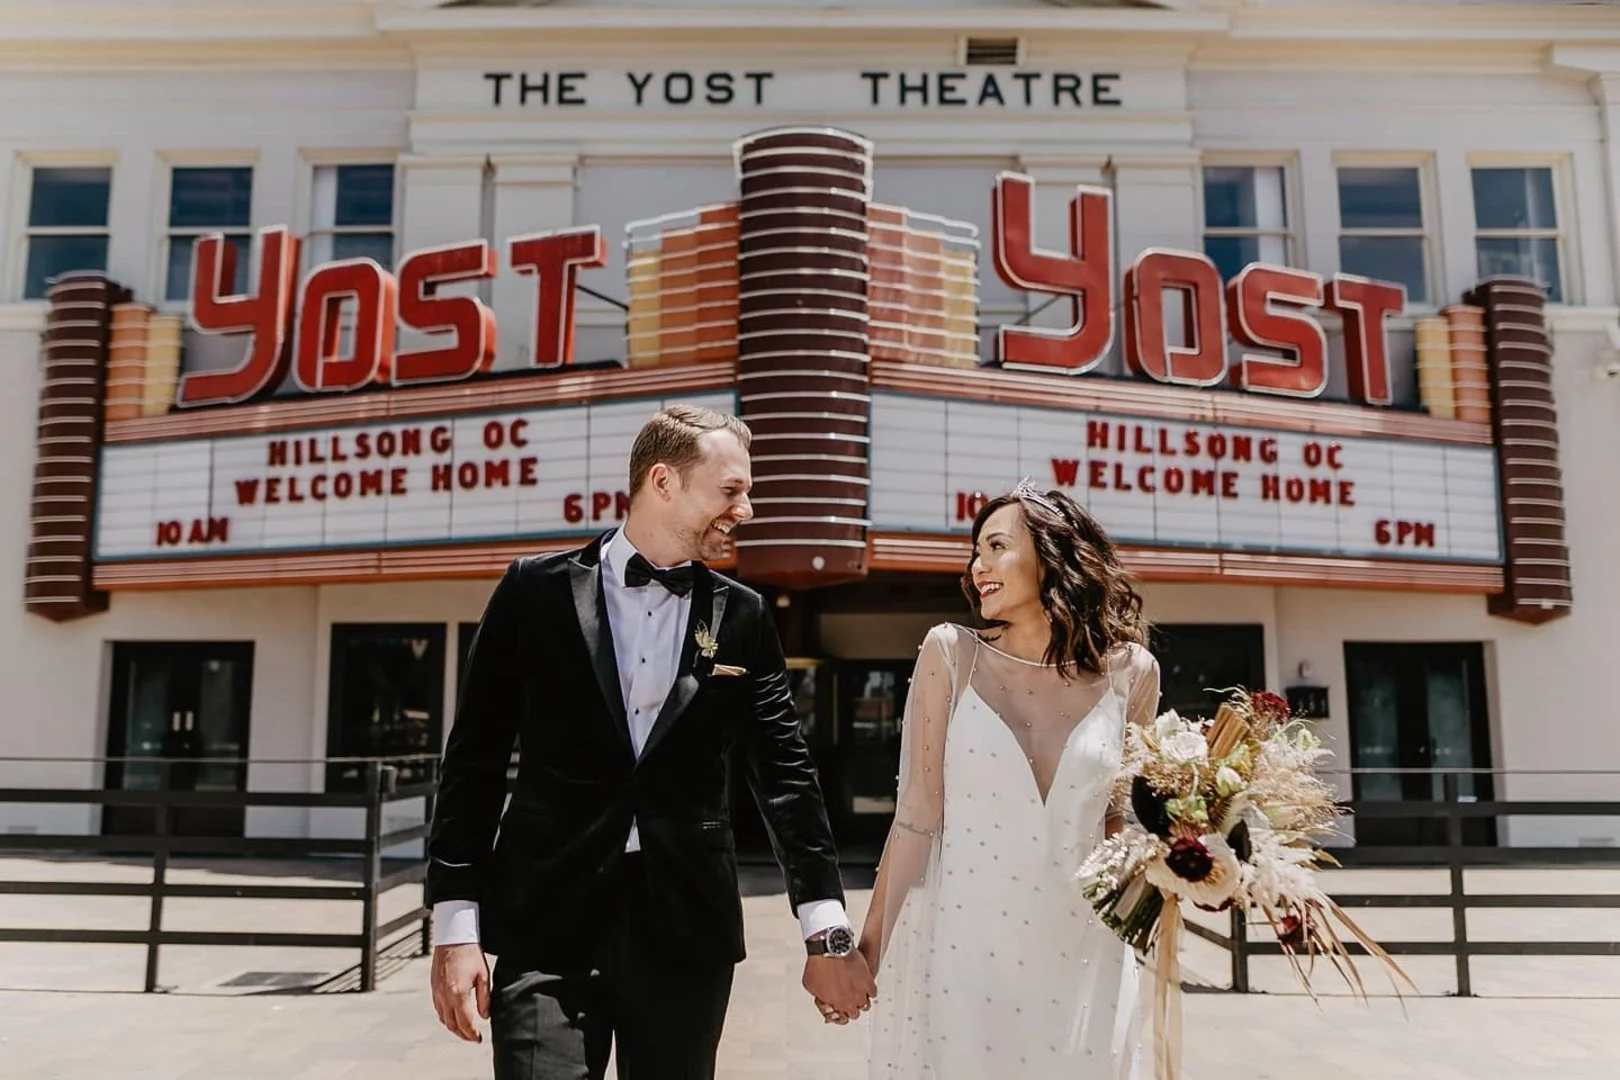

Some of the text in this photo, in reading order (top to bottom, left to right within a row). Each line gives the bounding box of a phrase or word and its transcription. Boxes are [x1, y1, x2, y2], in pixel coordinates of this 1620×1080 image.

[483, 71, 1122, 107] THE YOST THEATRE
[992, 170, 1408, 407] YOST
[177, 223, 608, 410] YOST
[268, 418, 530, 467] HILLSONG OC
[1086, 419, 1344, 470] HILLSONG OC
[234, 457, 539, 506] WELCOME HOME
[1051, 458, 1356, 506] WELCOME HOME
